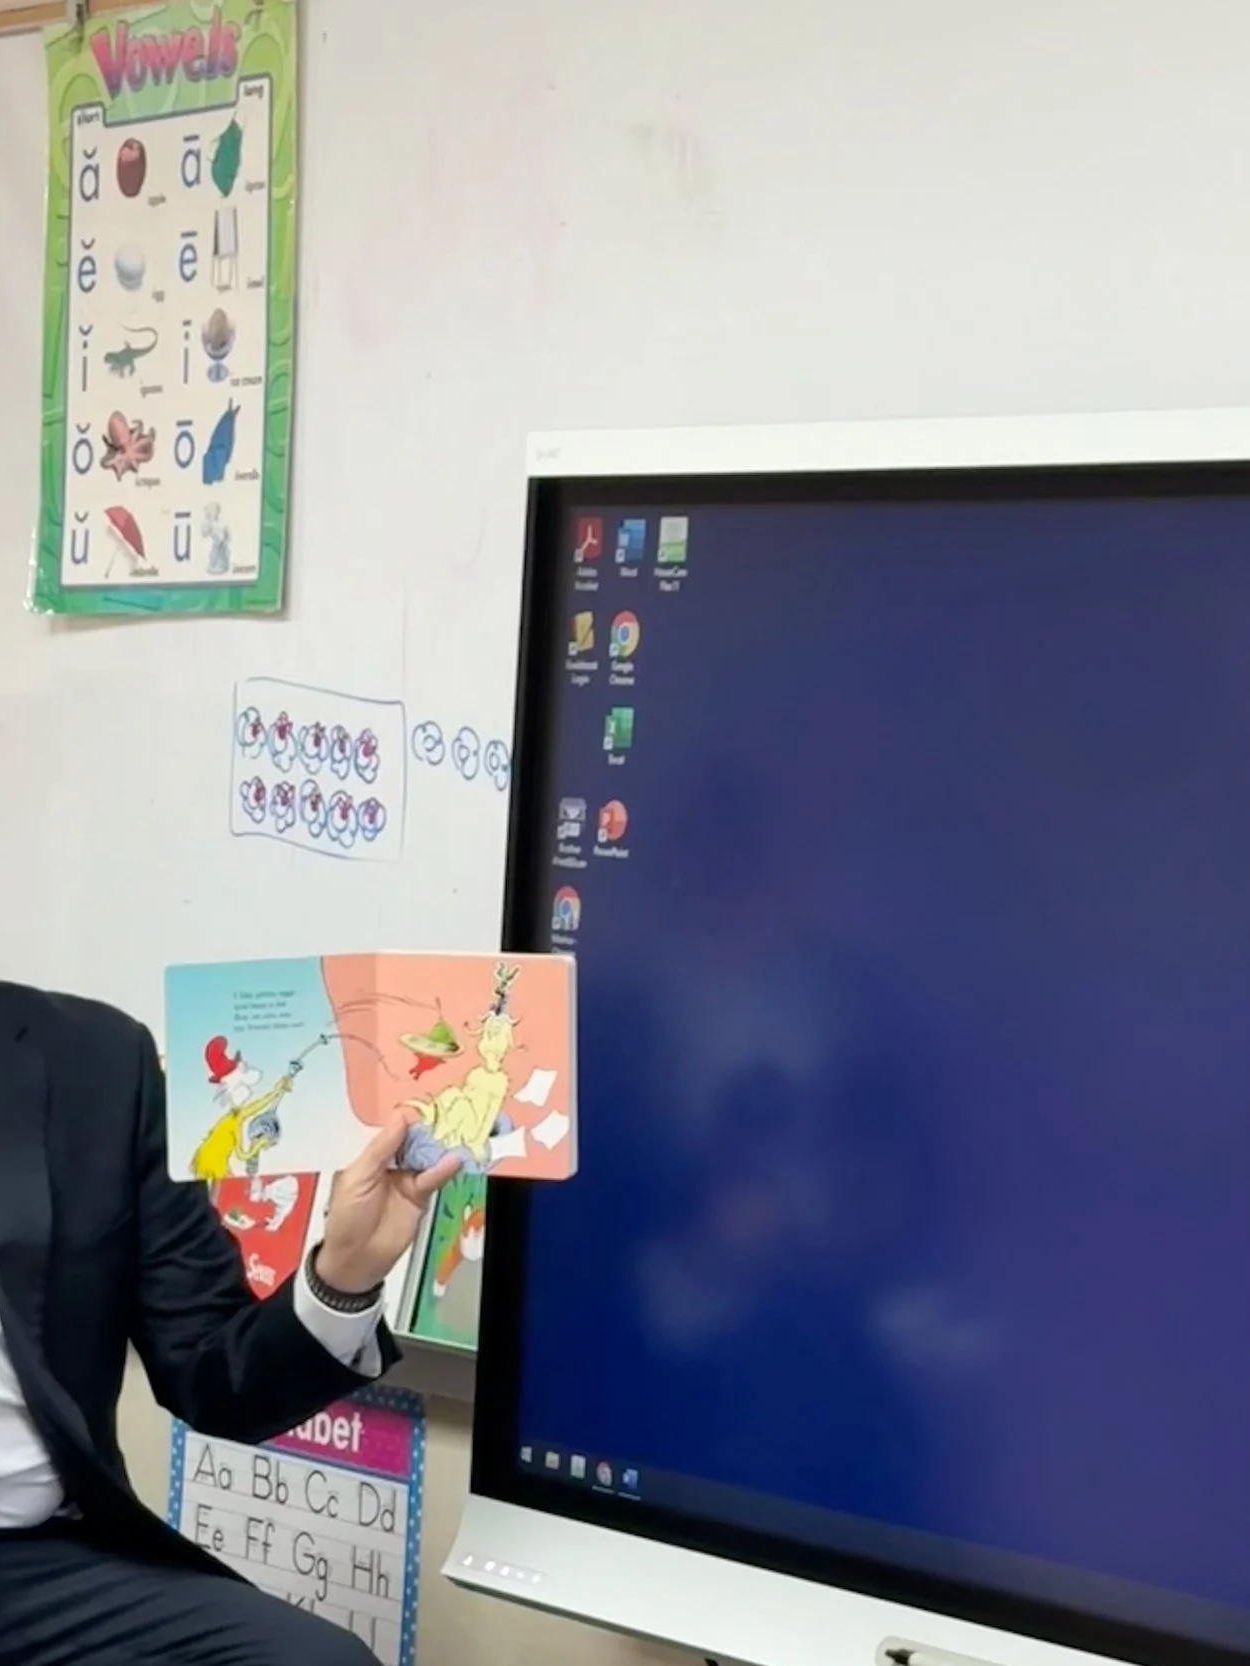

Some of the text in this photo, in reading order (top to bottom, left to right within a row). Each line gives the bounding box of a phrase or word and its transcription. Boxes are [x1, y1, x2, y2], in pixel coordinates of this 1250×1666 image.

[89, 4, 243, 100] Vowels
[193, 1443, 397, 1533] Aa Bb Cc Dd
[195, 1503, 390, 1602] Ee Ff Gg Hh
